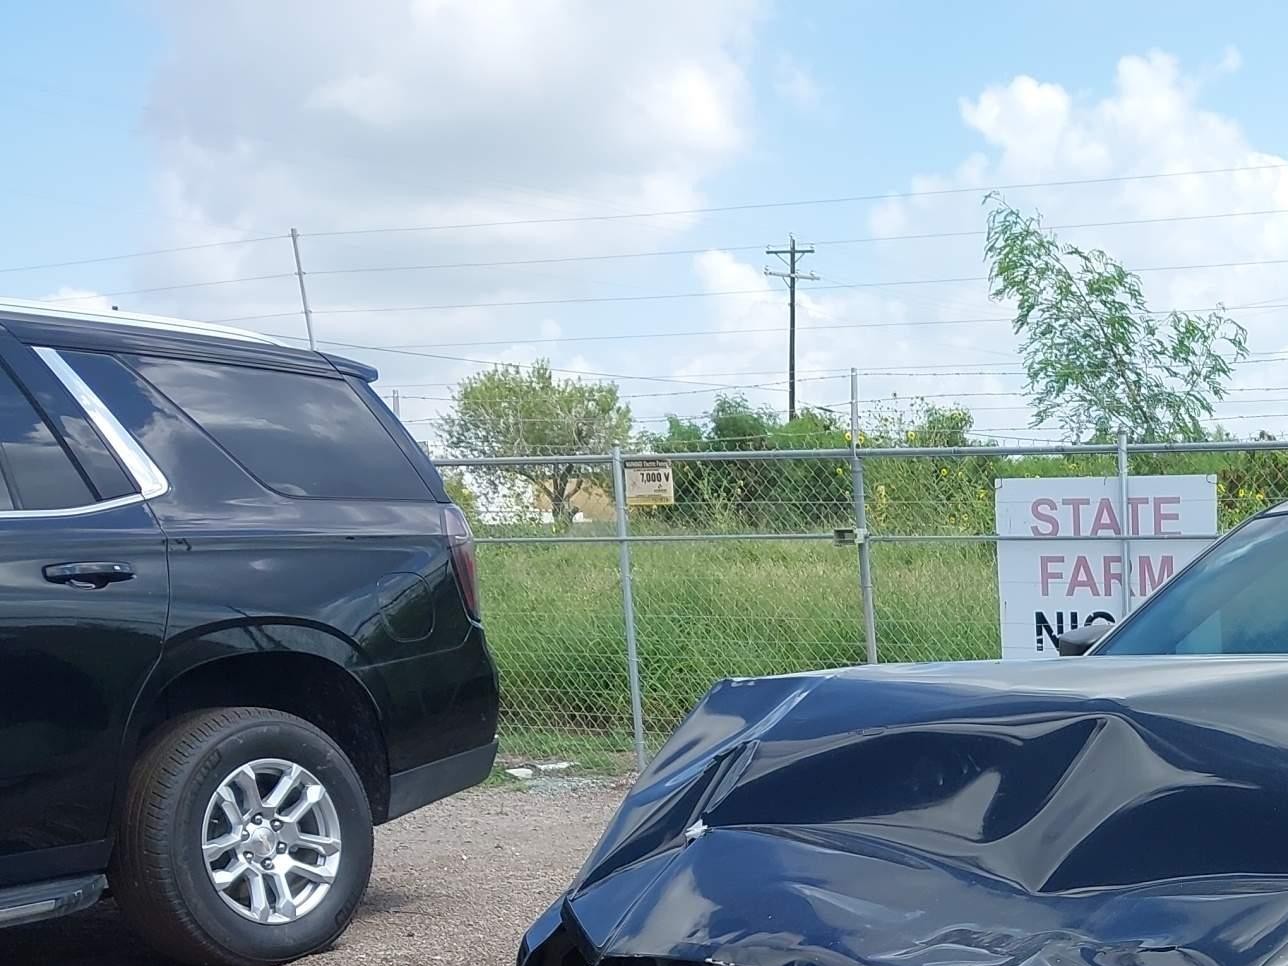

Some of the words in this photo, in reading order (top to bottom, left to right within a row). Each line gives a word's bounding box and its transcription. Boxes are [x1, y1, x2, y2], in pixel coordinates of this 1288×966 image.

[664, 472, 670, 482] V
[1030, 496, 1182, 537] STATE
[1040, 555, 1174, 597] FARM
